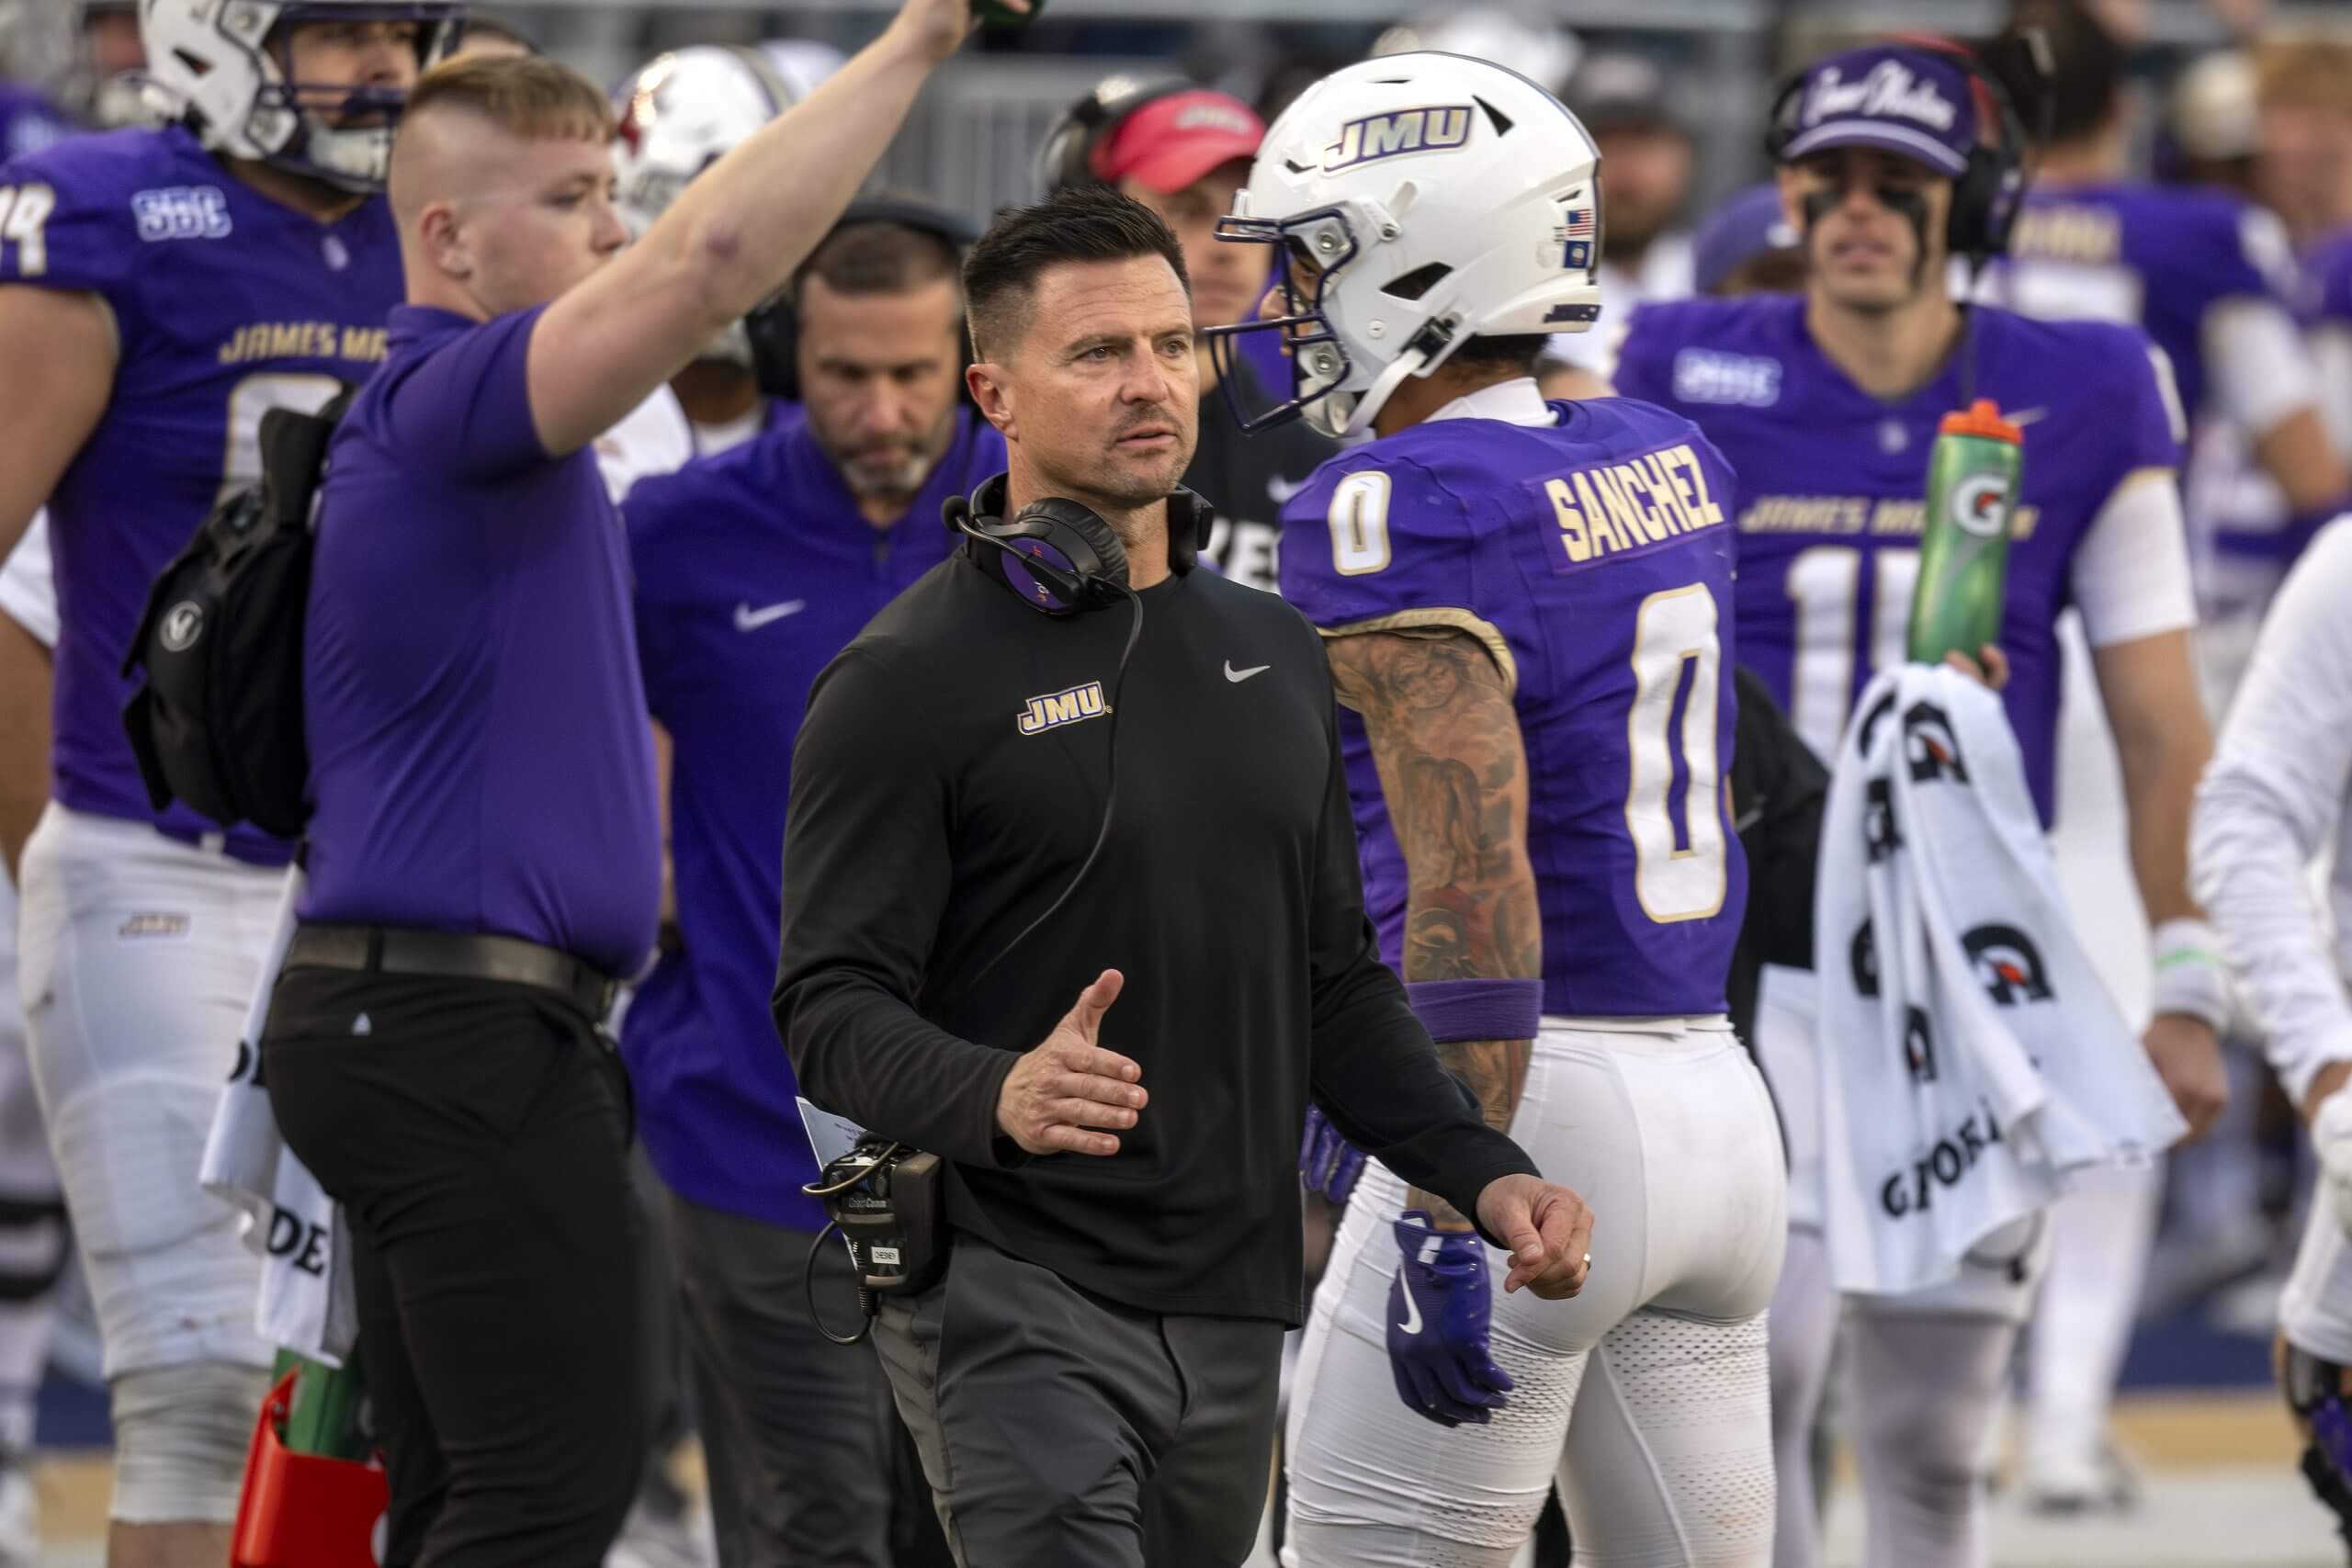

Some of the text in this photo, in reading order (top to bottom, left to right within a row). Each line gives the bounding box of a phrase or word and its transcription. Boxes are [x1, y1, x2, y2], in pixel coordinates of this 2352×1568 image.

[1324, 106, 1473, 172] JMU
[219, 322, 337, 364] JAMES
[1329, 471, 1391, 576] 0
[1544, 445, 1724, 562] SANCHEZ
[1953, 475, 2009, 536] G
[1017, 681, 1106, 736] JMU
[1625, 581, 1726, 924] 0
